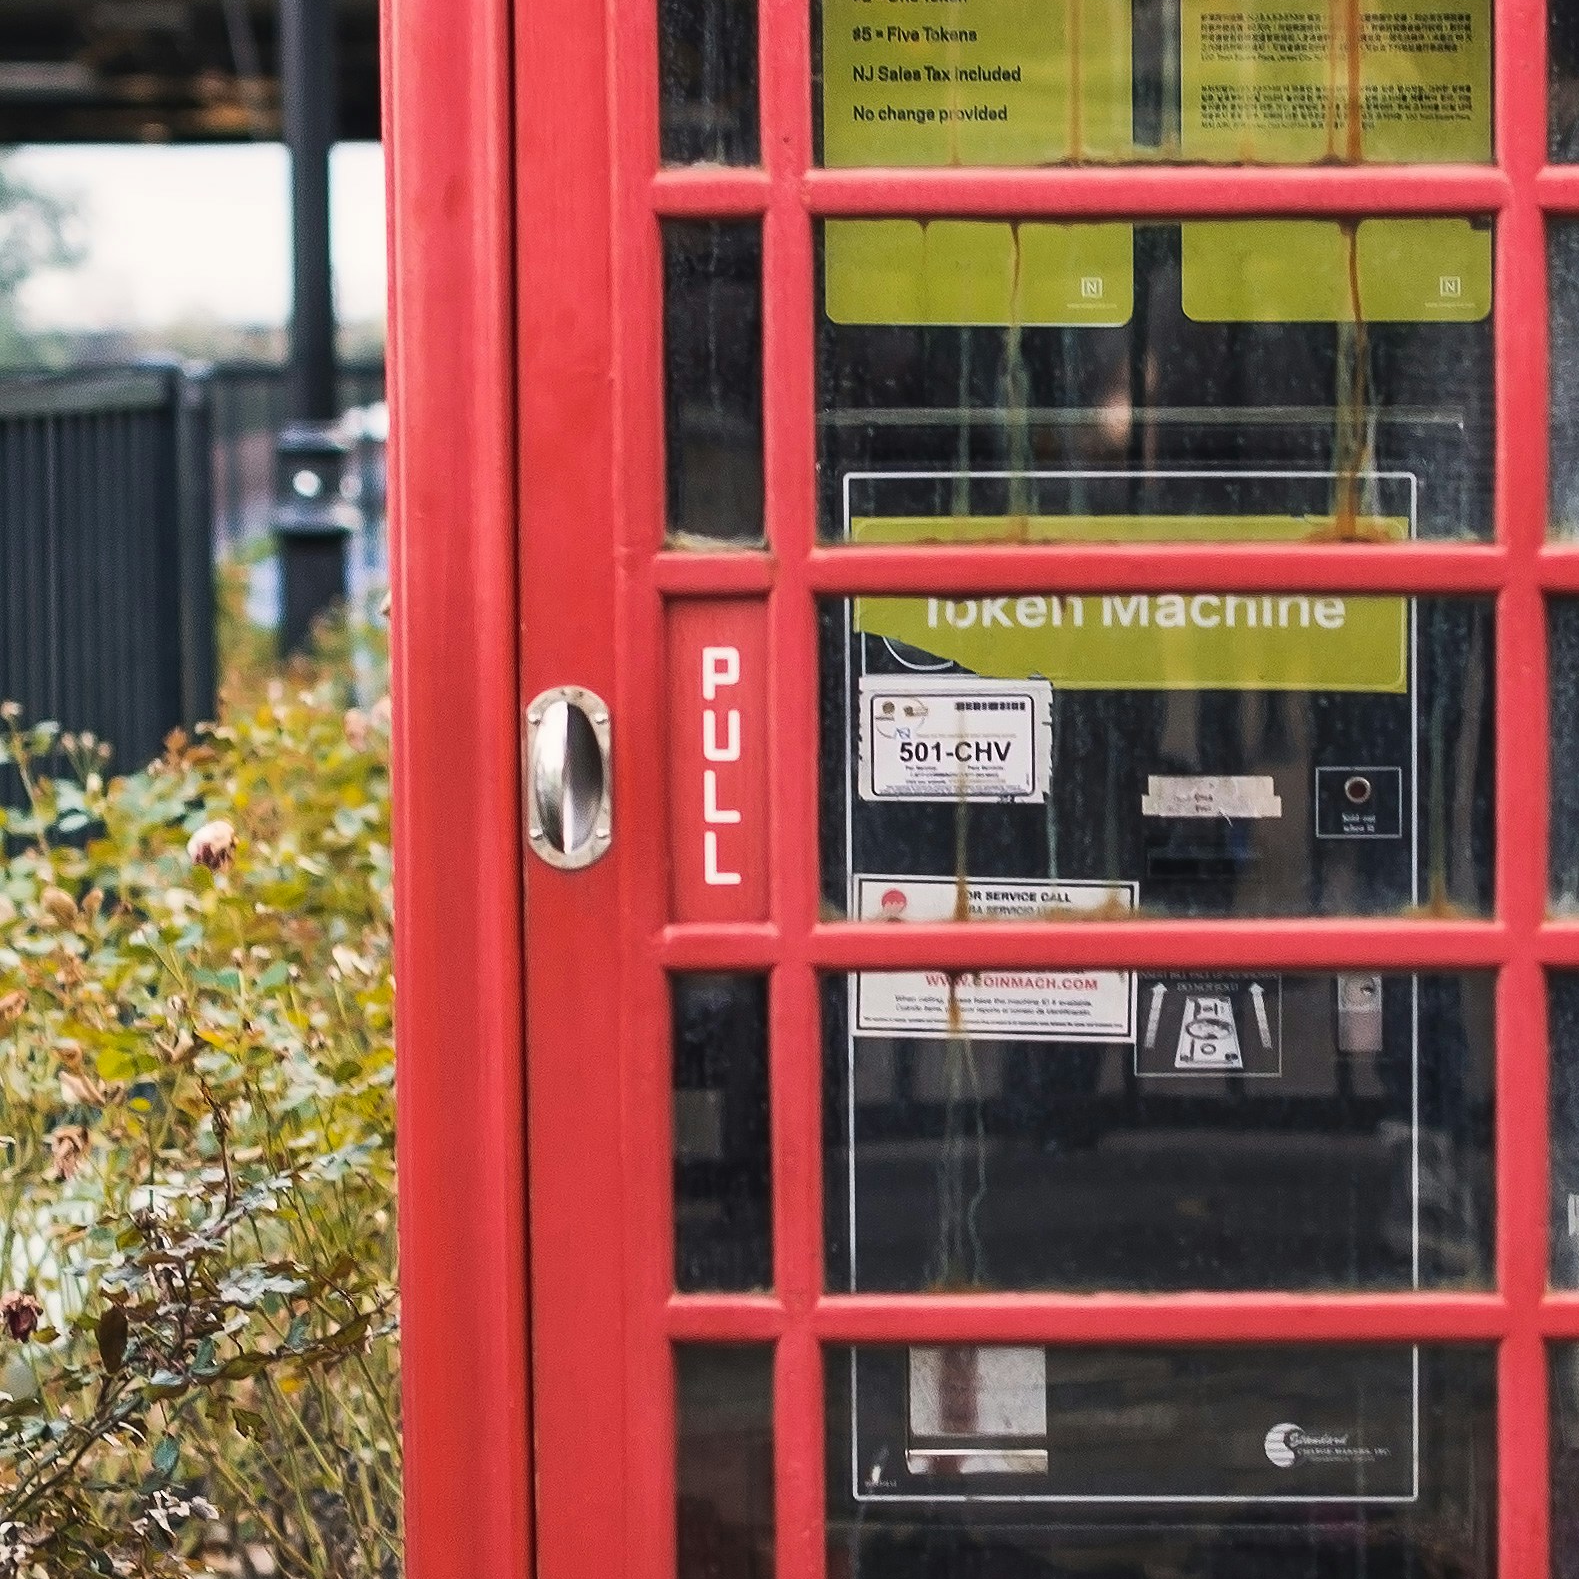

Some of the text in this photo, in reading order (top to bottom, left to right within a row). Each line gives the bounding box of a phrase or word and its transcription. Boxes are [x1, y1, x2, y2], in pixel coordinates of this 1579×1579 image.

[886, 26, 920, 42] Five
[922, 26, 978, 43] Tokens
[853, 65, 874, 82] NJ
[878, 65, 922, 82] Sales
[923, 65, 951, 82] Tax
[853, 105, 875, 121] No
[878, 105, 936, 124] change
[1102, 594, 1347, 630] Machine
[899, 740, 1012, 763] 501-CHV
[701, 645, 742, 886] PULL
[985, 891, 1037, 902] SERVICE
[1040, 891, 1071, 903] CALL
